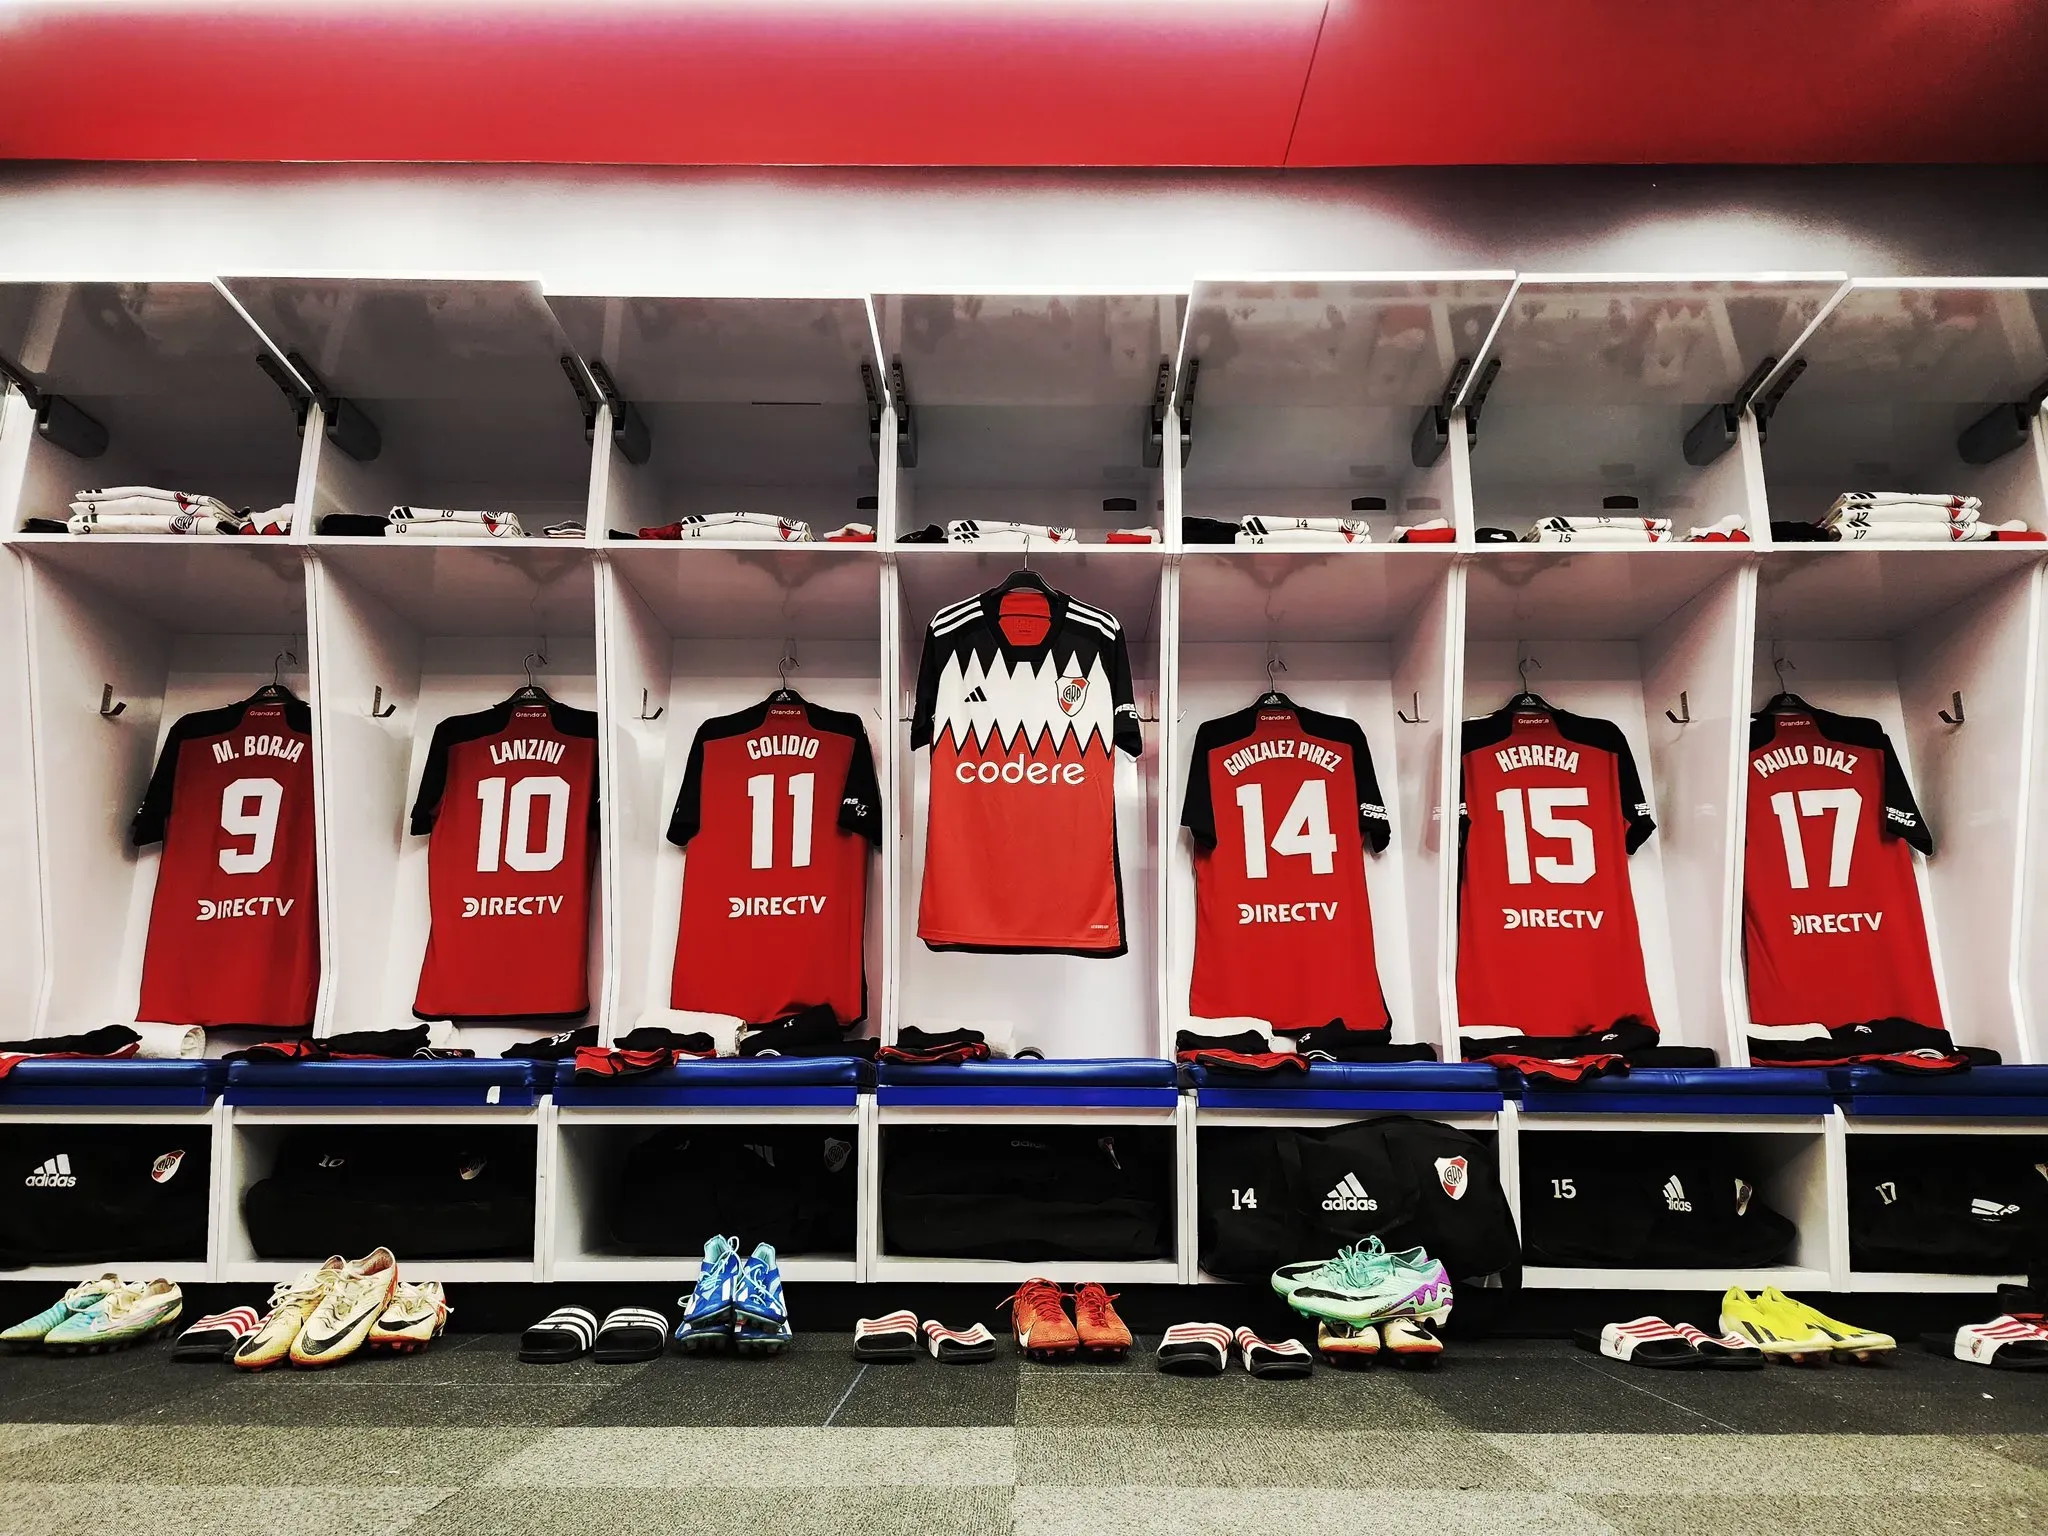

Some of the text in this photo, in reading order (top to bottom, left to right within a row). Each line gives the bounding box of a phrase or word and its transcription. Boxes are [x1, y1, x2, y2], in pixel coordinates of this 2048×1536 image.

[88, 503, 96, 513] 9
[395, 523, 407, 533] 10
[1295, 518, 1308, 528] 14
[1853, 529, 1867, 539] 17
[1558, 533, 1571, 543] 15
[213, 735, 305, 764] M. BORJA
[489, 739, 566, 765] LANZINI
[746, 735, 820, 760] COLIDIO
[1222, 740, 1343, 777] GONZALEZ PIREZ
[1495, 745, 1580, 774] HERRERA
[955, 753, 1085, 785] codere
[1753, 746, 1859, 779] PAULO DIAZ
[218, 777, 284, 875] 9
[476, 775, 571, 872] 10
[747, 772, 815, 869] 11
[1235, 779, 1338, 879] 14
[1495, 787, 1597, 885] 15
[1770, 787, 1863, 889] 17
[196, 896, 295, 921] DIRECTV
[461, 895, 564, 918] DIRECTV
[728, 895, 827, 918] DIRECTV
[1237, 901, 1338, 925] DIRECTV
[1501, 908, 1604, 929] DIRECTV
[1790, 911, 1883, 936] DIRECTV
[318, 1153, 345, 1168] 10
[25, 1173, 77, 1188] adidas
[1551, 1178, 1577, 1199] 15
[1231, 1187, 1258, 1211] 14
[1321, 1196, 1378, 1211] adidas
[1875, 1182, 1897, 1205] 17
